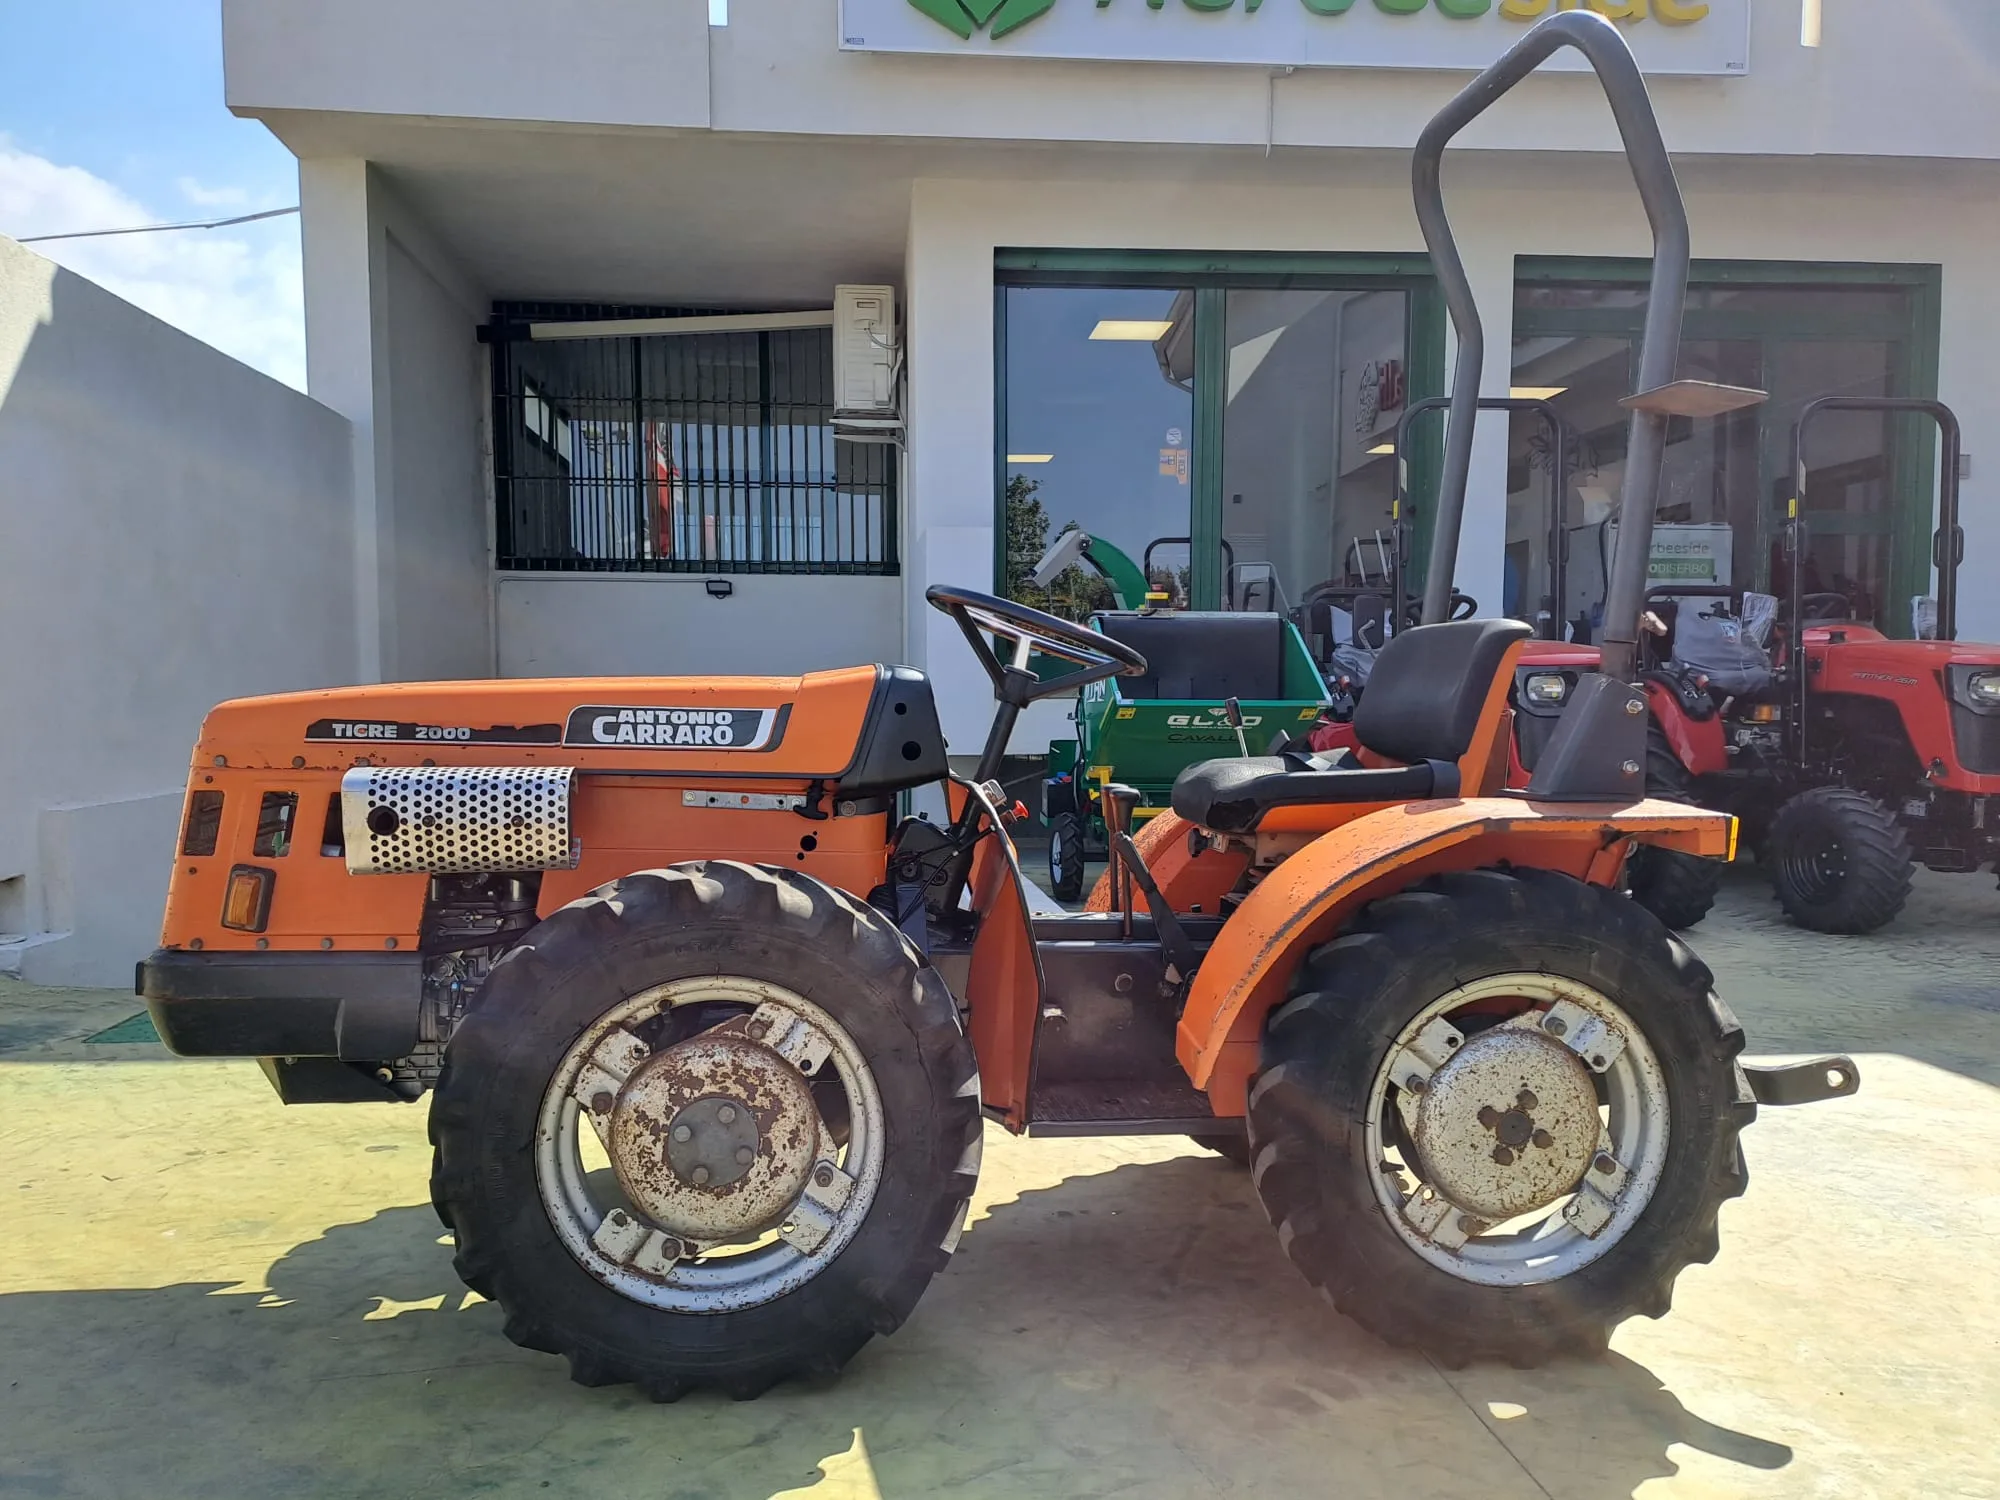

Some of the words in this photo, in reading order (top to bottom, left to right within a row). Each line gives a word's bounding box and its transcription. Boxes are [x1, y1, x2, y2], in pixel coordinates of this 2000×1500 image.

[1648, 563, 1708, 574] ODISERBO
[618, 710, 733, 725] ANTONIO
[332, 723, 397, 738] TIGRE
[415, 726, 471, 740] 2000
[592, 716, 734, 745] CARRARO
